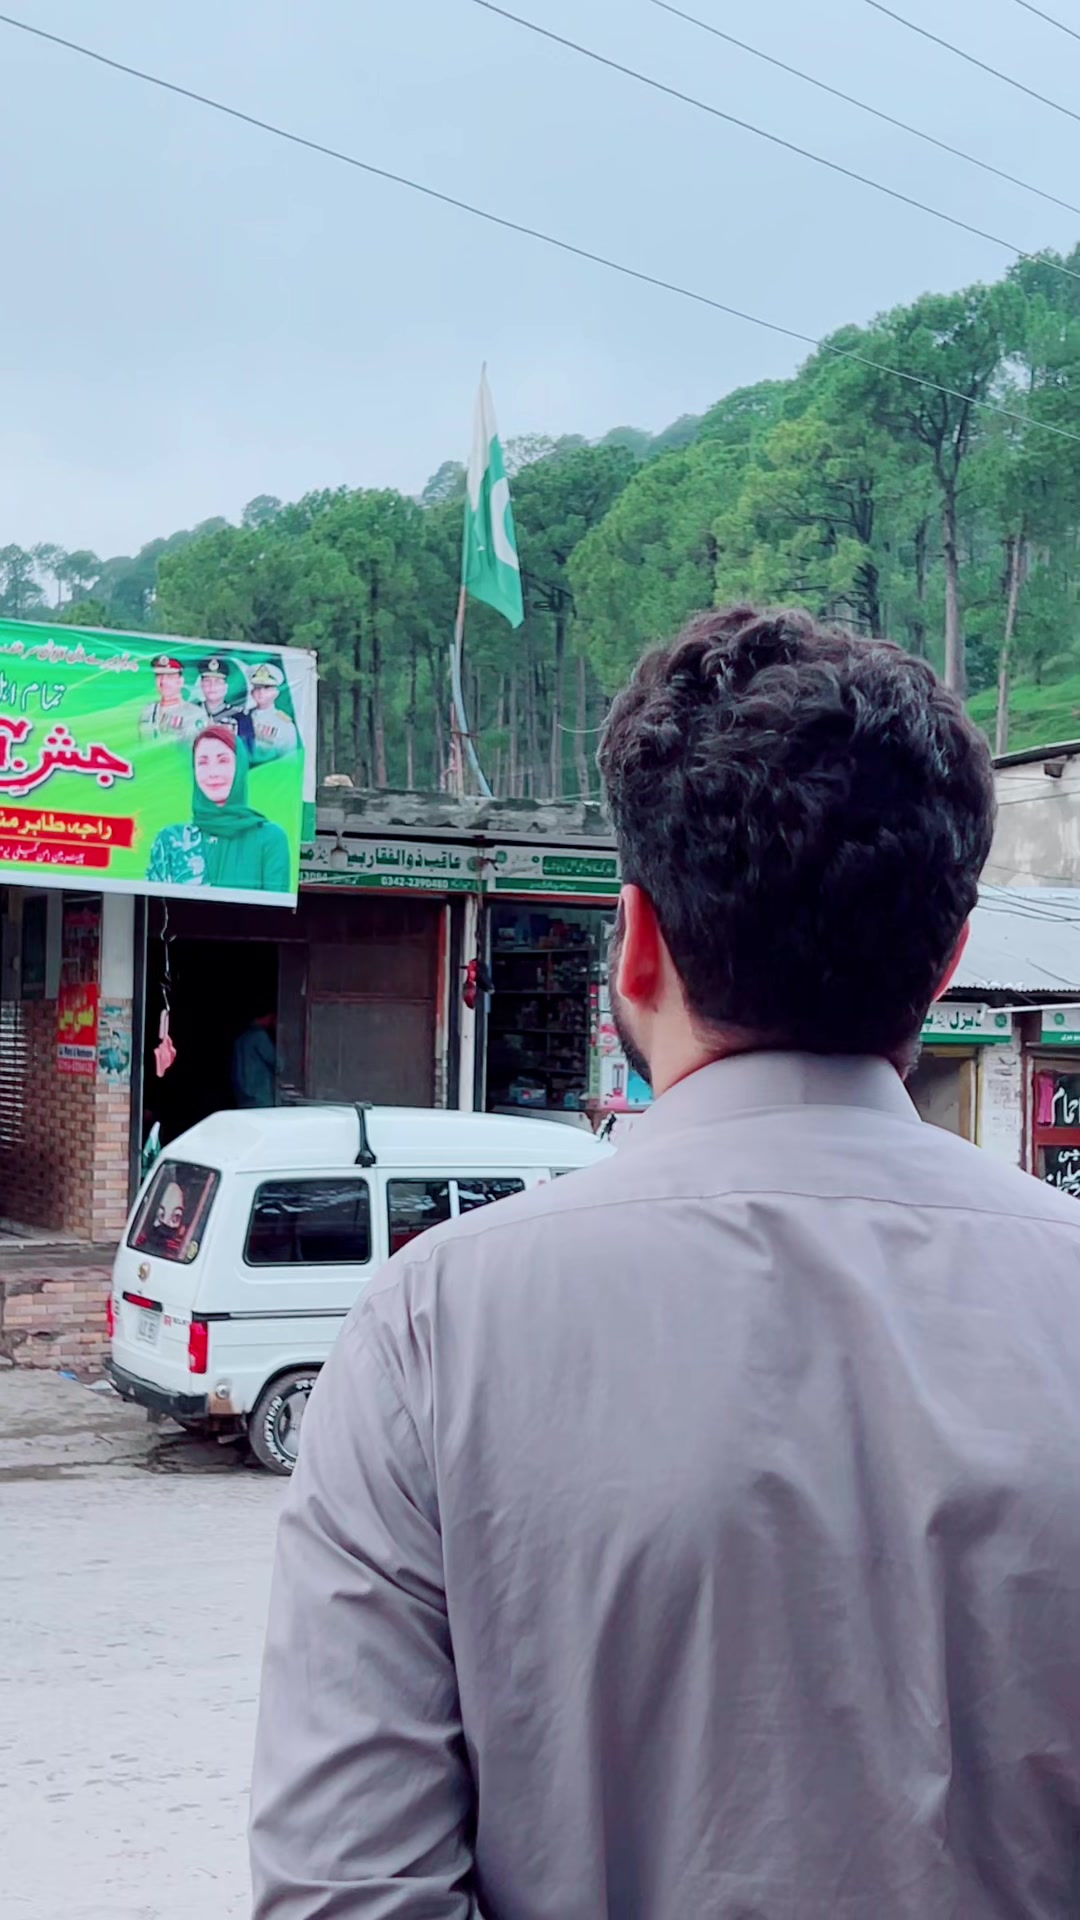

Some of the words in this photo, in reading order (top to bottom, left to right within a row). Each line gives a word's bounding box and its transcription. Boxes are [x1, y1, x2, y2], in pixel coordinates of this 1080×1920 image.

[21, 683, 66, 711] تمام
[17, 812, 67, 837] طاہر
[67, 818, 113, 841] راجہ
[424, 851, 462, 873] عاقب
